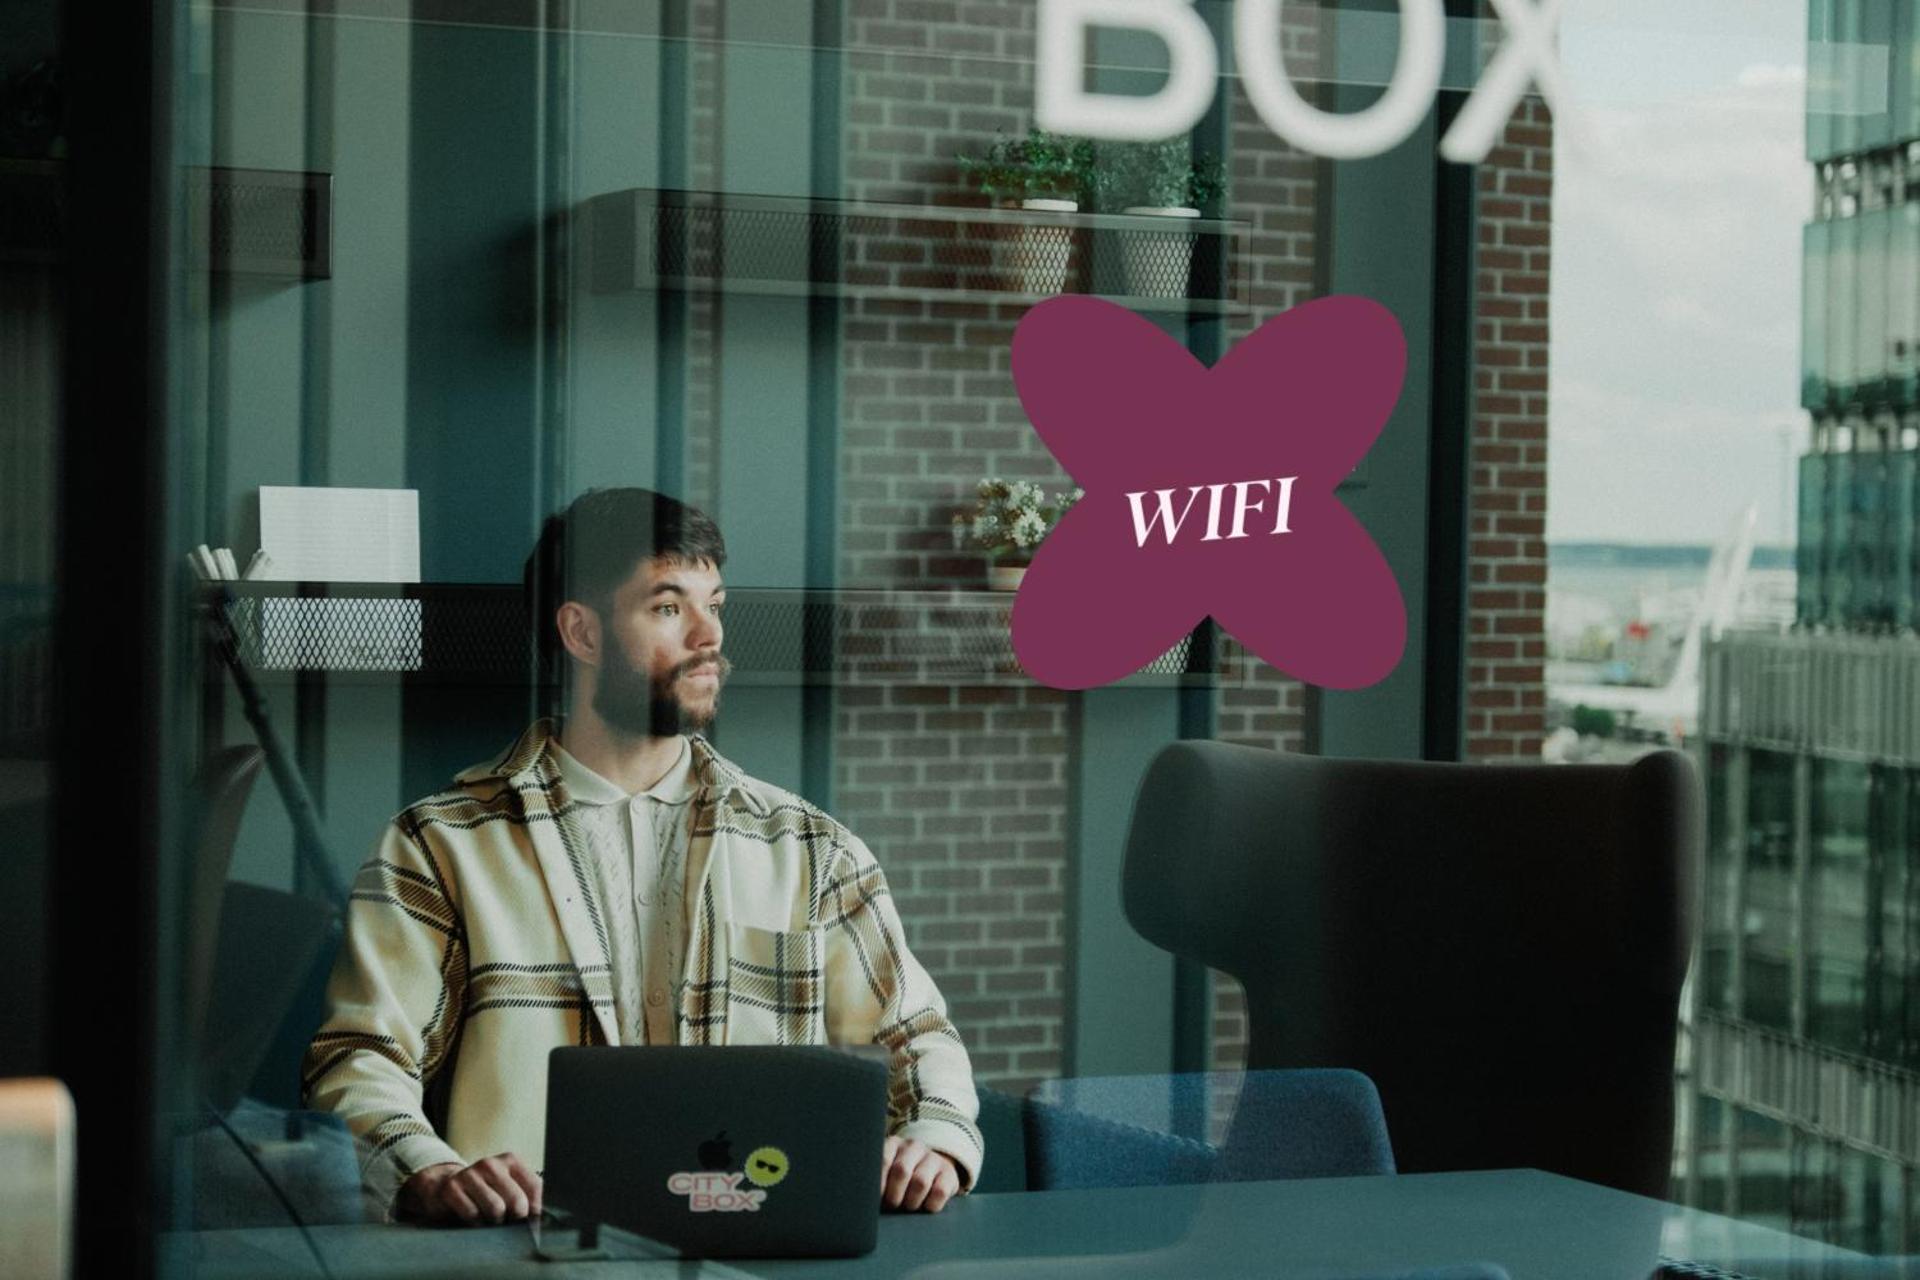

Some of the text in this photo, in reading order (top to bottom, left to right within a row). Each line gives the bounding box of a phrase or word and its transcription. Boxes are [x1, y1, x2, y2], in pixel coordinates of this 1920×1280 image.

[1036, 0, 1566, 162] BOX
[669, 1174, 742, 1193] CITY
[691, 1192, 757, 1210] BOX
